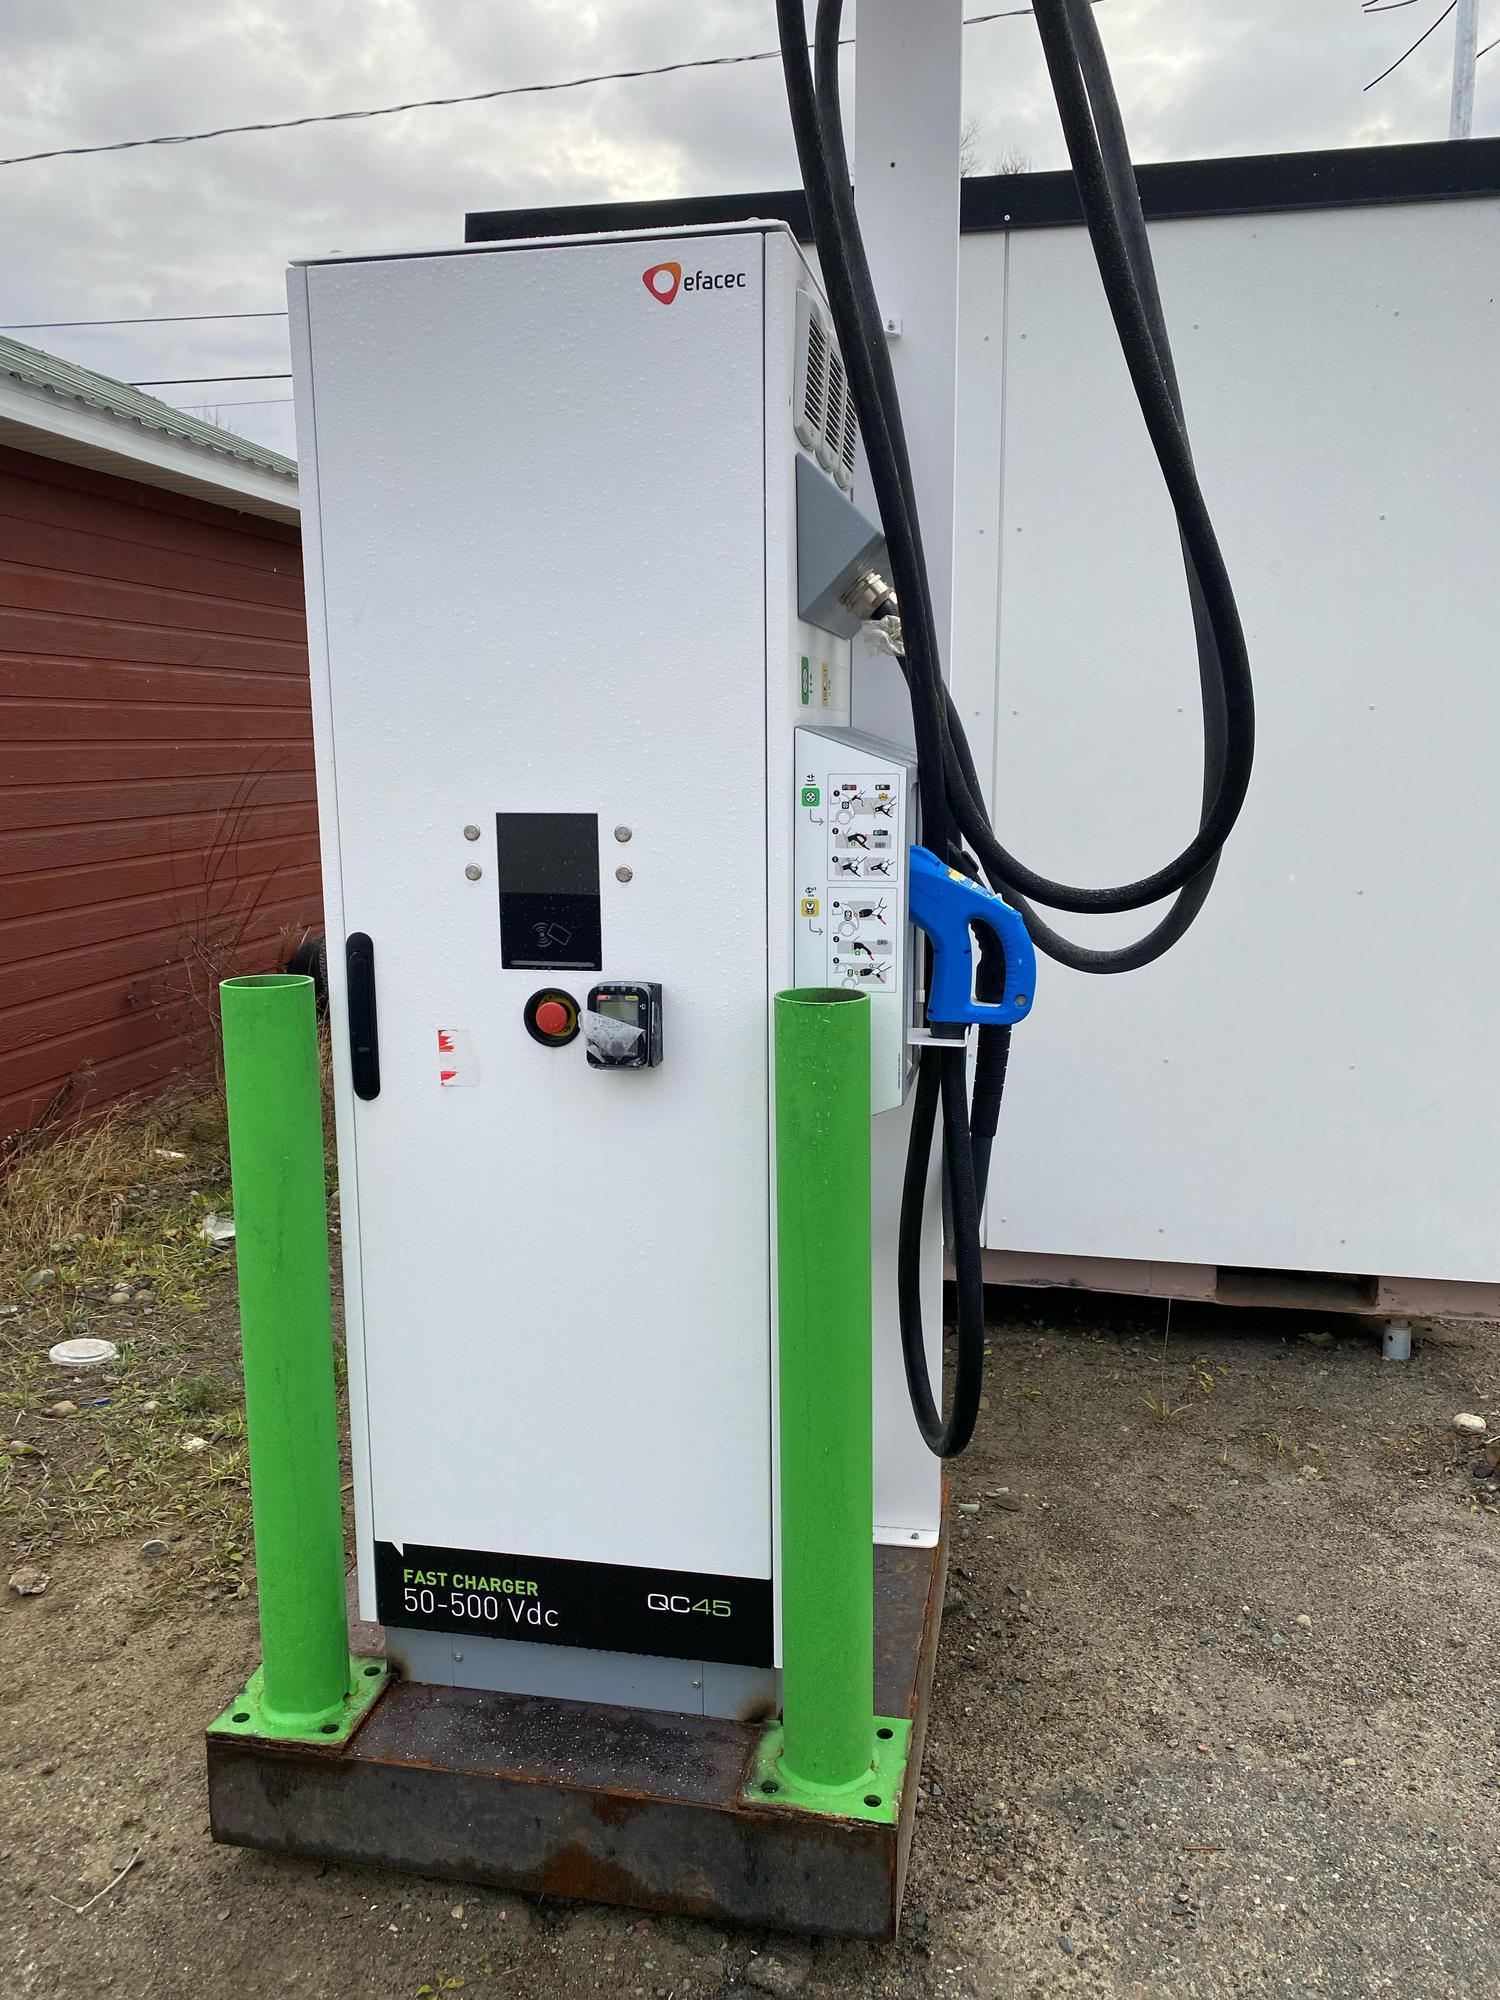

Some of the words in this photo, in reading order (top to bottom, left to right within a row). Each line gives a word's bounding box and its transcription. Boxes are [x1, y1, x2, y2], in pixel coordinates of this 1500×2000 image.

[684, 271, 746, 291] efacec
[403, 1569, 448, 1587] FAST
[452, 1574, 539, 1596] CHARGER
[404, 1588, 499, 1621] 50-500
[507, 1598, 559, 1627] Vdc
[647, 1593, 731, 1617] QC45
